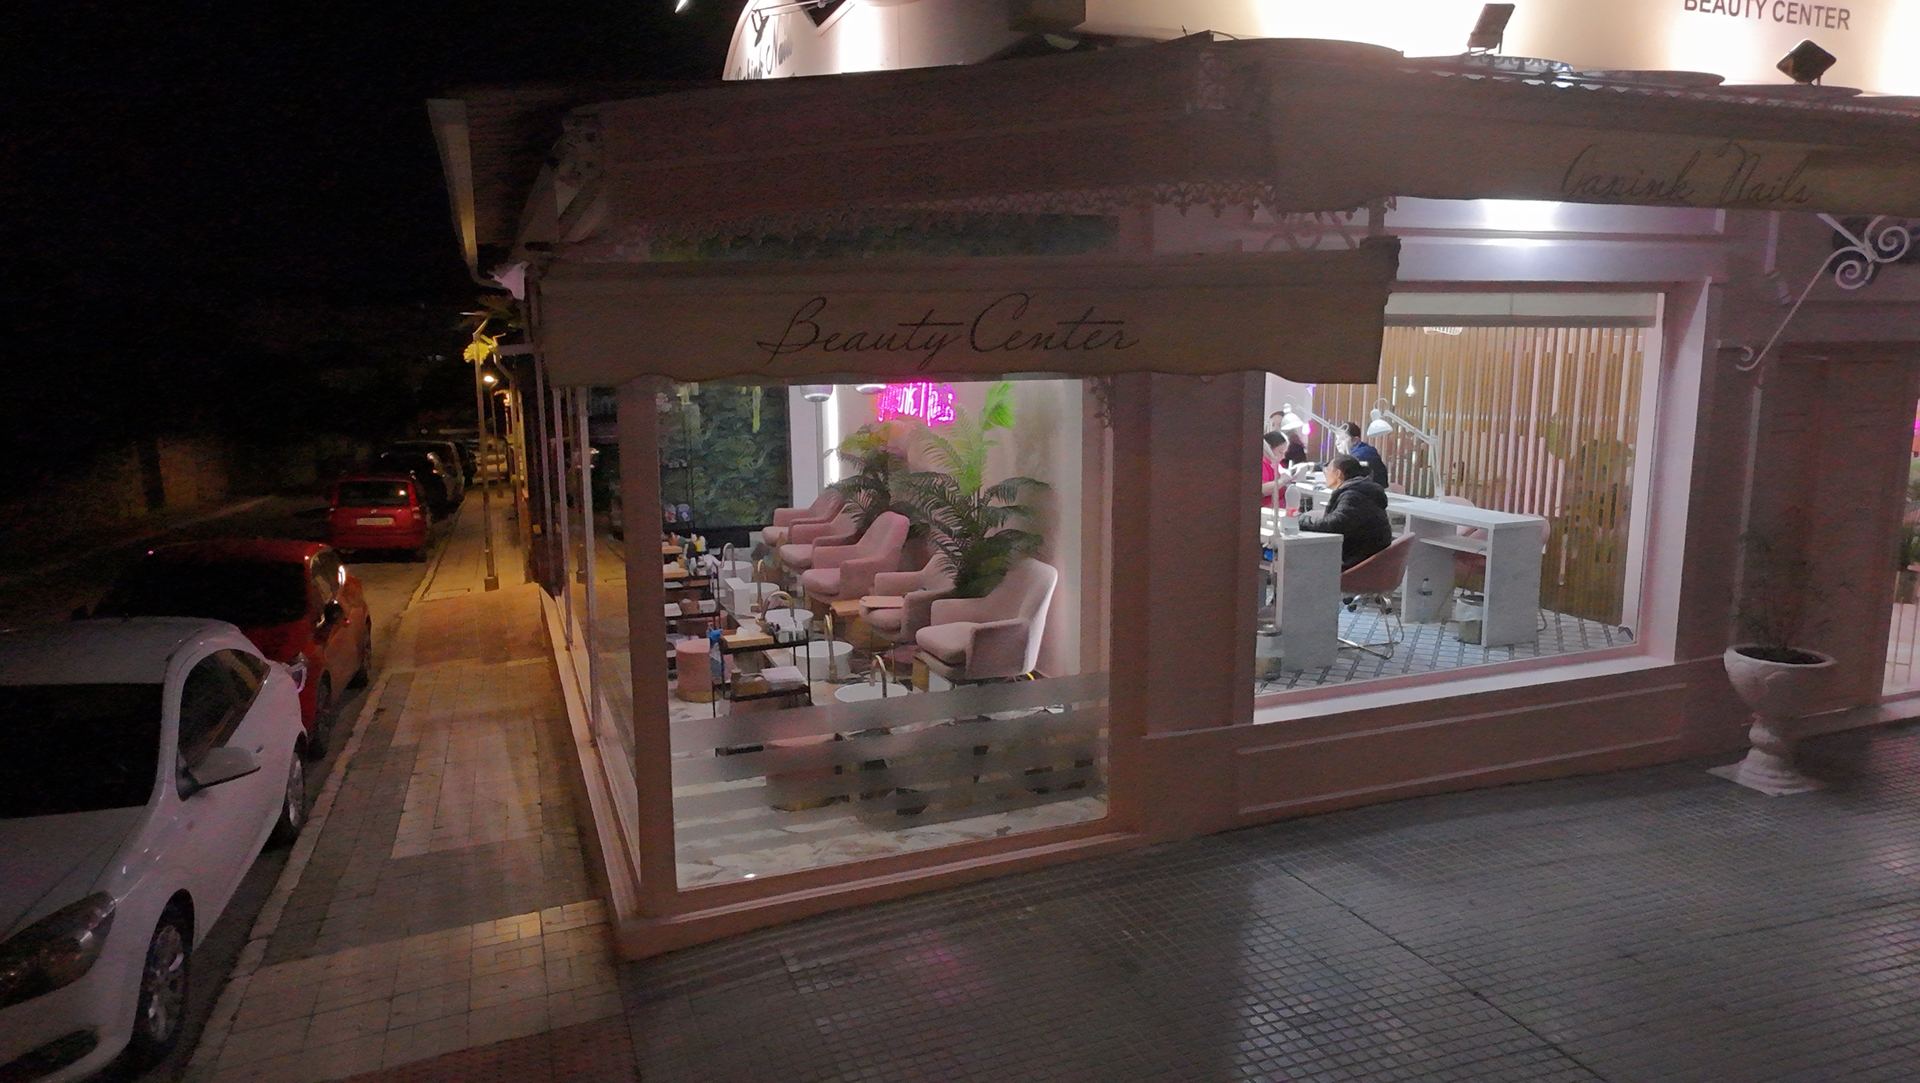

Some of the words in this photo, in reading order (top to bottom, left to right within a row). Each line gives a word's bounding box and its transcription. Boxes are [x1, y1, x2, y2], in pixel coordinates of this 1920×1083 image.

[1772, 1, 1851, 31] CENTER
[1715, 138, 1813, 204] Nails
[756, 296, 965, 371] Beauty
[969, 292, 1140, 353] Center
